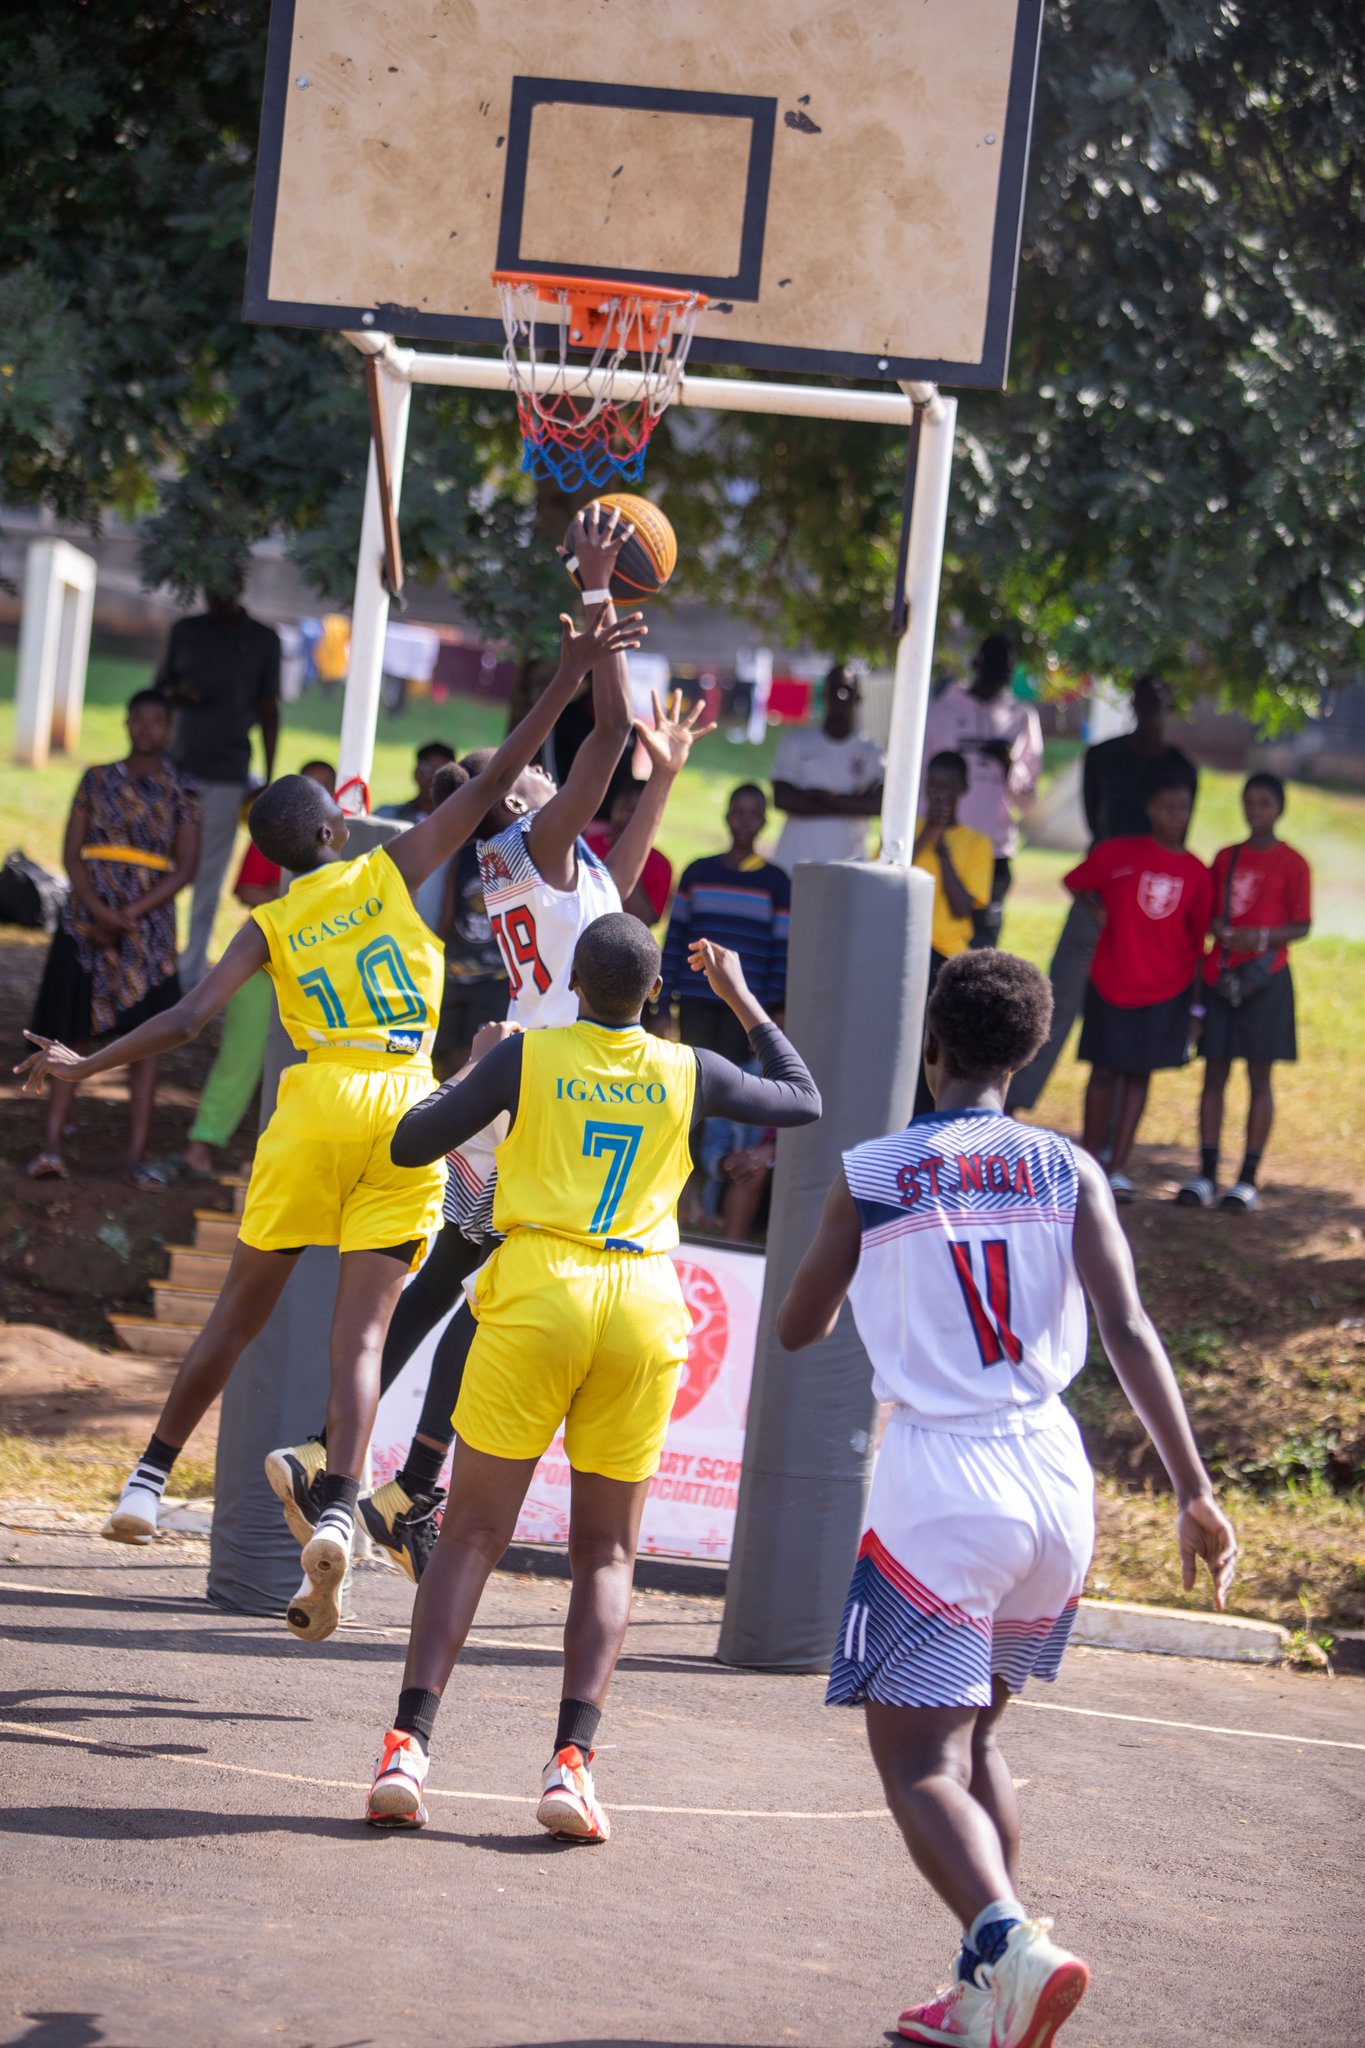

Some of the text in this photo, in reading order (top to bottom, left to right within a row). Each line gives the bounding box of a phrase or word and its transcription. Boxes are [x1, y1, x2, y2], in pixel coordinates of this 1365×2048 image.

[288, 897, 383, 953] IGASCO
[297, 934, 428, 1028] 10
[556, 1077, 667, 1104] IGASCO
[582, 1119, 644, 1233] 7
[947, 1239, 1024, 1370] 11
